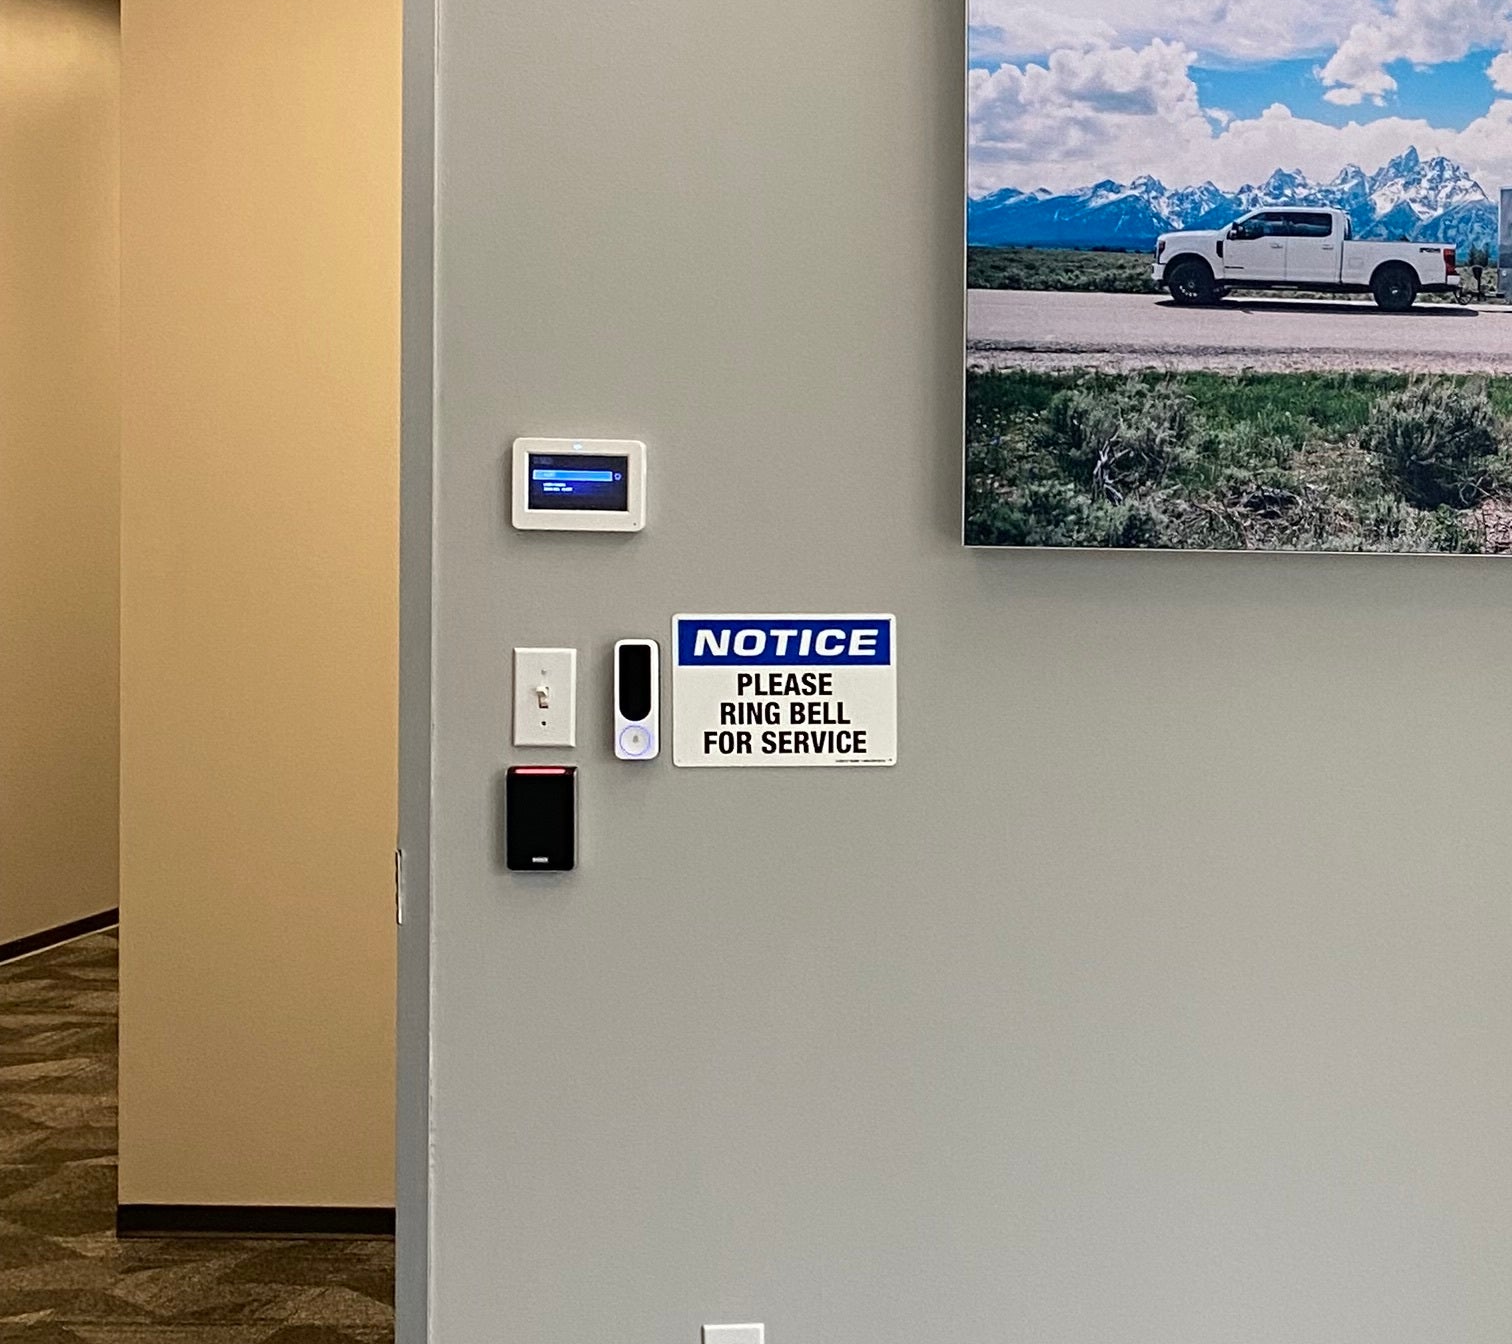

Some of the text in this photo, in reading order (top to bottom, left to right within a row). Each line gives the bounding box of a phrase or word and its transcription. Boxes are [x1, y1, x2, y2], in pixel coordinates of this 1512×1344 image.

[693, 629, 879, 656] NOTICE
[737, 672, 833, 696] PLEASE
[720, 701, 851, 725] RING BELL
[704, 730, 867, 754] FOR SERVICE
